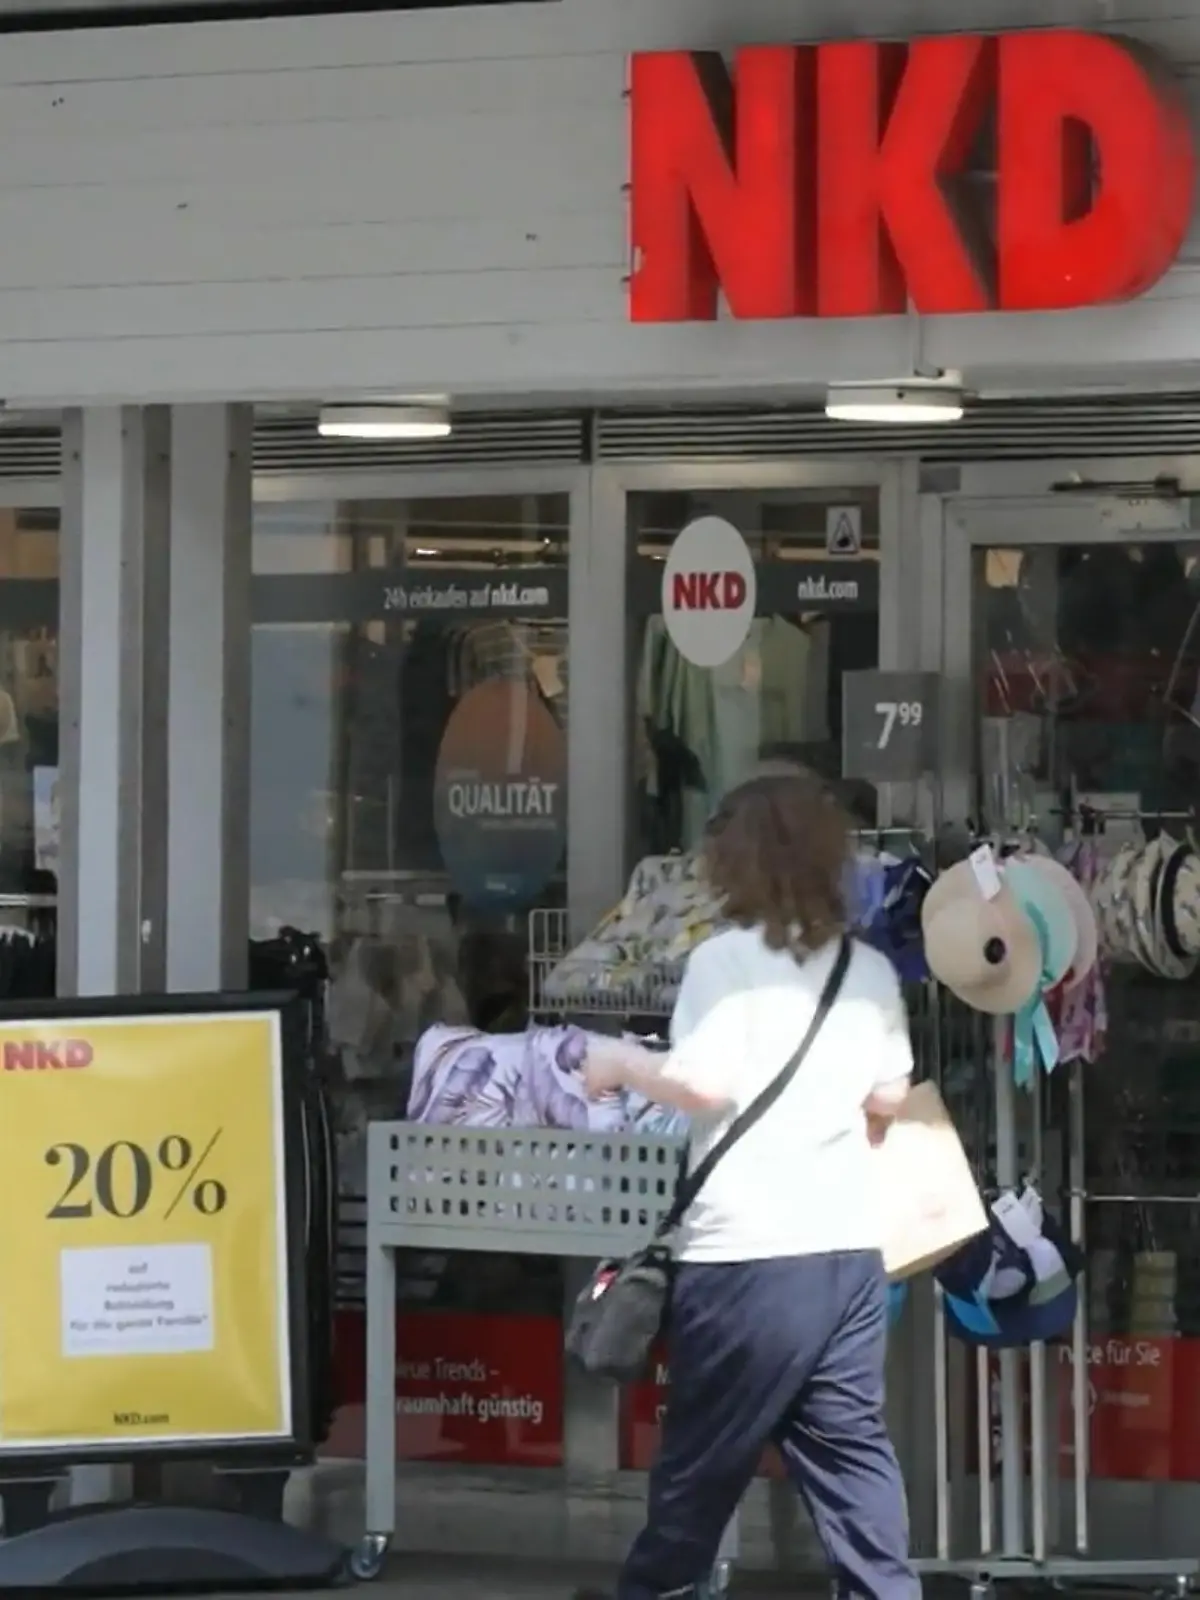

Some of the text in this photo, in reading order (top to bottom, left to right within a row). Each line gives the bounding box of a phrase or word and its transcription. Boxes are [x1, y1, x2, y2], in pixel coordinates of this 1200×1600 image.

[629, 28, 1196, 322] NKD
[383, 582, 549, 610] 24h einkaufen auf nkd.com
[673, 571, 747, 611] NKD
[797, 575, 859, 600] nkd.com
[448, 776, 558, 818] QUALITÄT
[3, 1039, 93, 1070] NKD
[44, 1126, 227, 1220] 20%
[1105, 1339, 1132, 1365] für
[1135, 1341, 1161, 1367] Sie
[434, 1357, 486, 1382] Trends
[396, 1392, 544, 1424] raumhaft günstig
